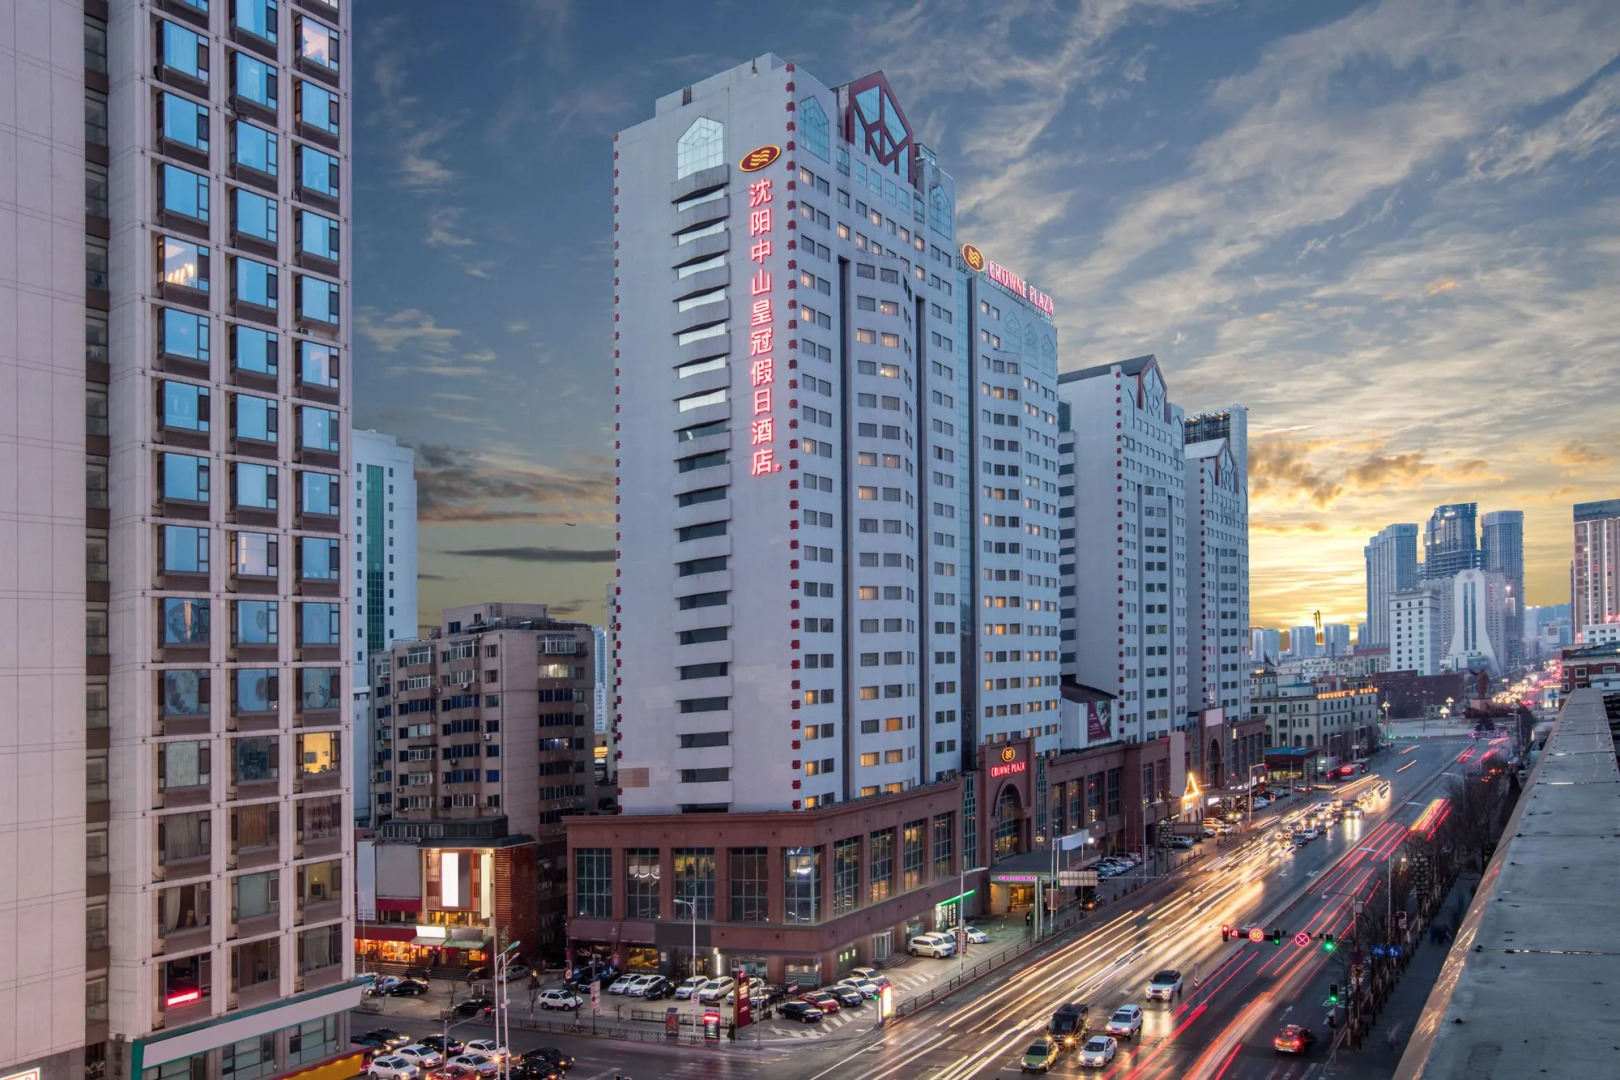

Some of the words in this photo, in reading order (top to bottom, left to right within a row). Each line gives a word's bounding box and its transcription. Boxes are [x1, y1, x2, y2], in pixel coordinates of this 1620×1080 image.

[988, 260, 1027, 299] CROWNE
[1029, 285, 1054, 315] PLAZA
[749, 178, 774, 477] 沈阳中山皇冠假日酒店
[991, 764, 1010, 778] CROWNE
[1011, 761, 1026, 773] PLAZA
